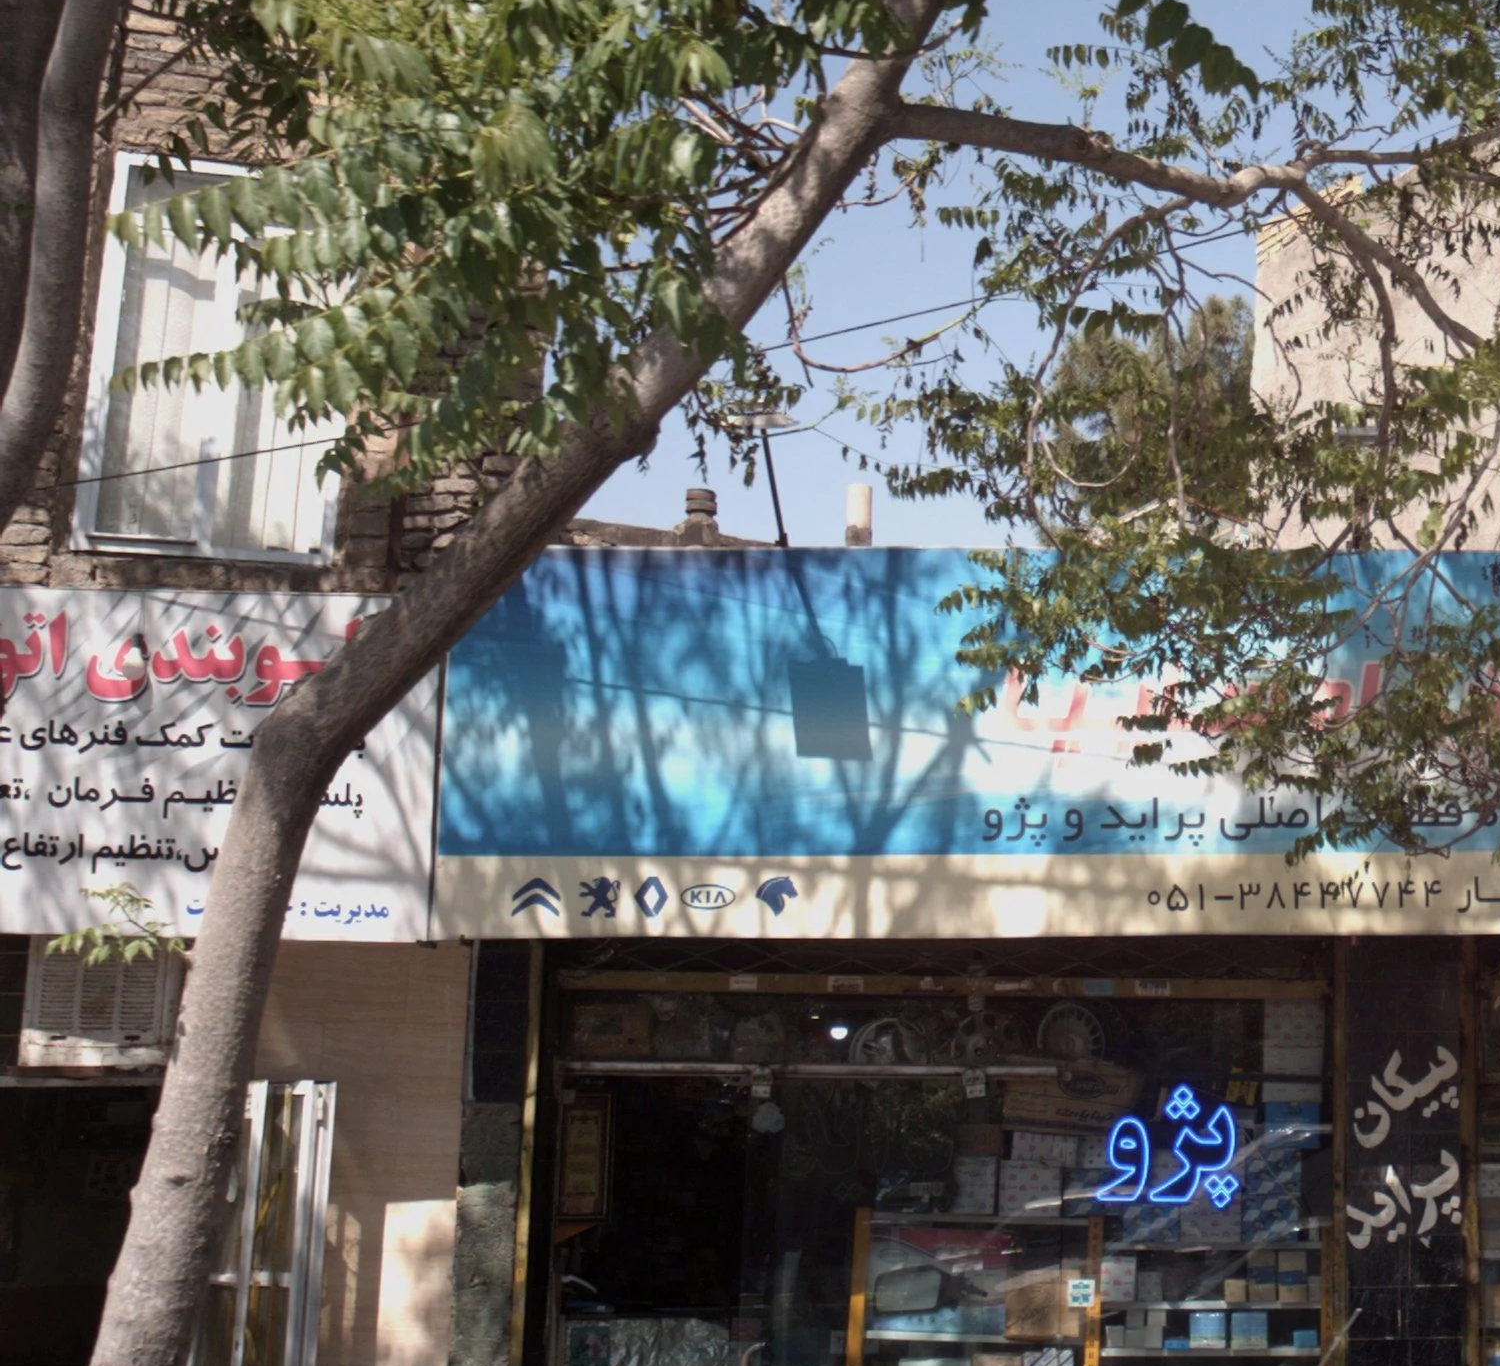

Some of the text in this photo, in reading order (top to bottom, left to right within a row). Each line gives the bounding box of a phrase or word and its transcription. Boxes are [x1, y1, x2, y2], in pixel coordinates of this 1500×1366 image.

[20, 719, 129, 753] فنرهای
[136, 723, 214, 750] کمک
[48, 776, 155, 811] فرمان
[982, 797, 1049, 847] پژو
[1064, 807, 1084, 841] و
[1100, 797, 1206, 846] پراید
[1, 833, 84, 871] ارتفاع
[314, 900, 389, 924] مدیریت
[1352, 1045, 1459, 1149] پیکان
[1095, 1083, 1240, 1209] پژو
[1345, 1149, 1462, 1250] پراید
